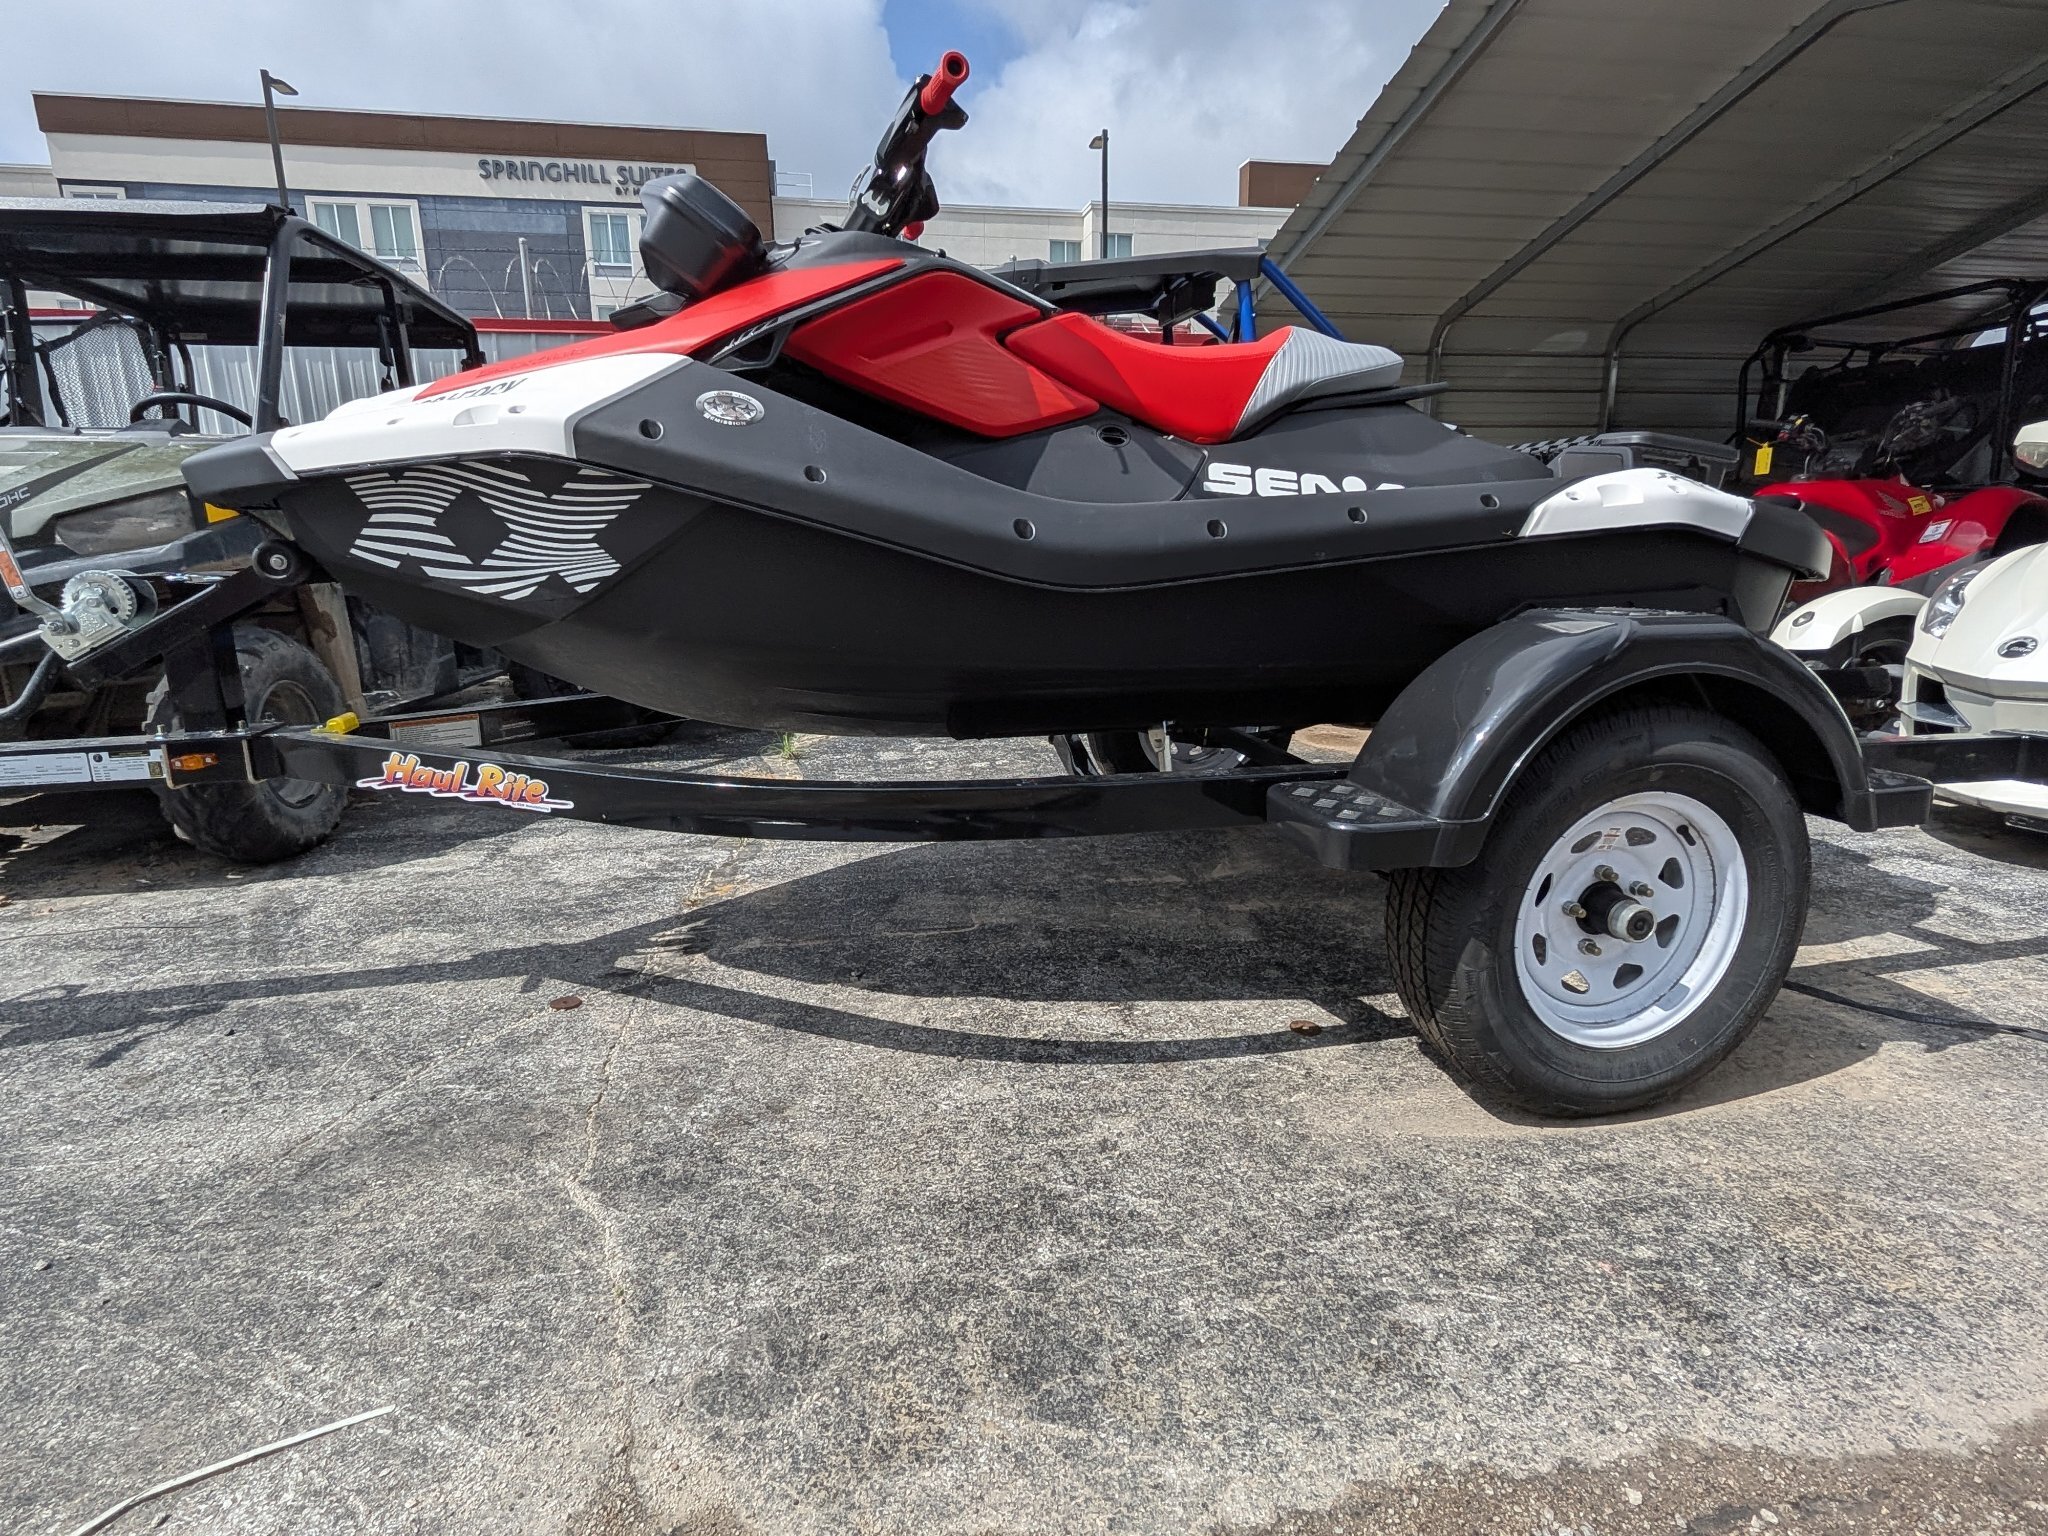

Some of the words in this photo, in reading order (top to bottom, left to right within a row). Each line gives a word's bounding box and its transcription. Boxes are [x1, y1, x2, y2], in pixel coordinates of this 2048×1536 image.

[477, 158, 611, 185] SPRINGHILL
[616, 165, 687, 186] SUIT
[384, 752, 466, 793] Haul
[476, 764, 548, 803] Rite
